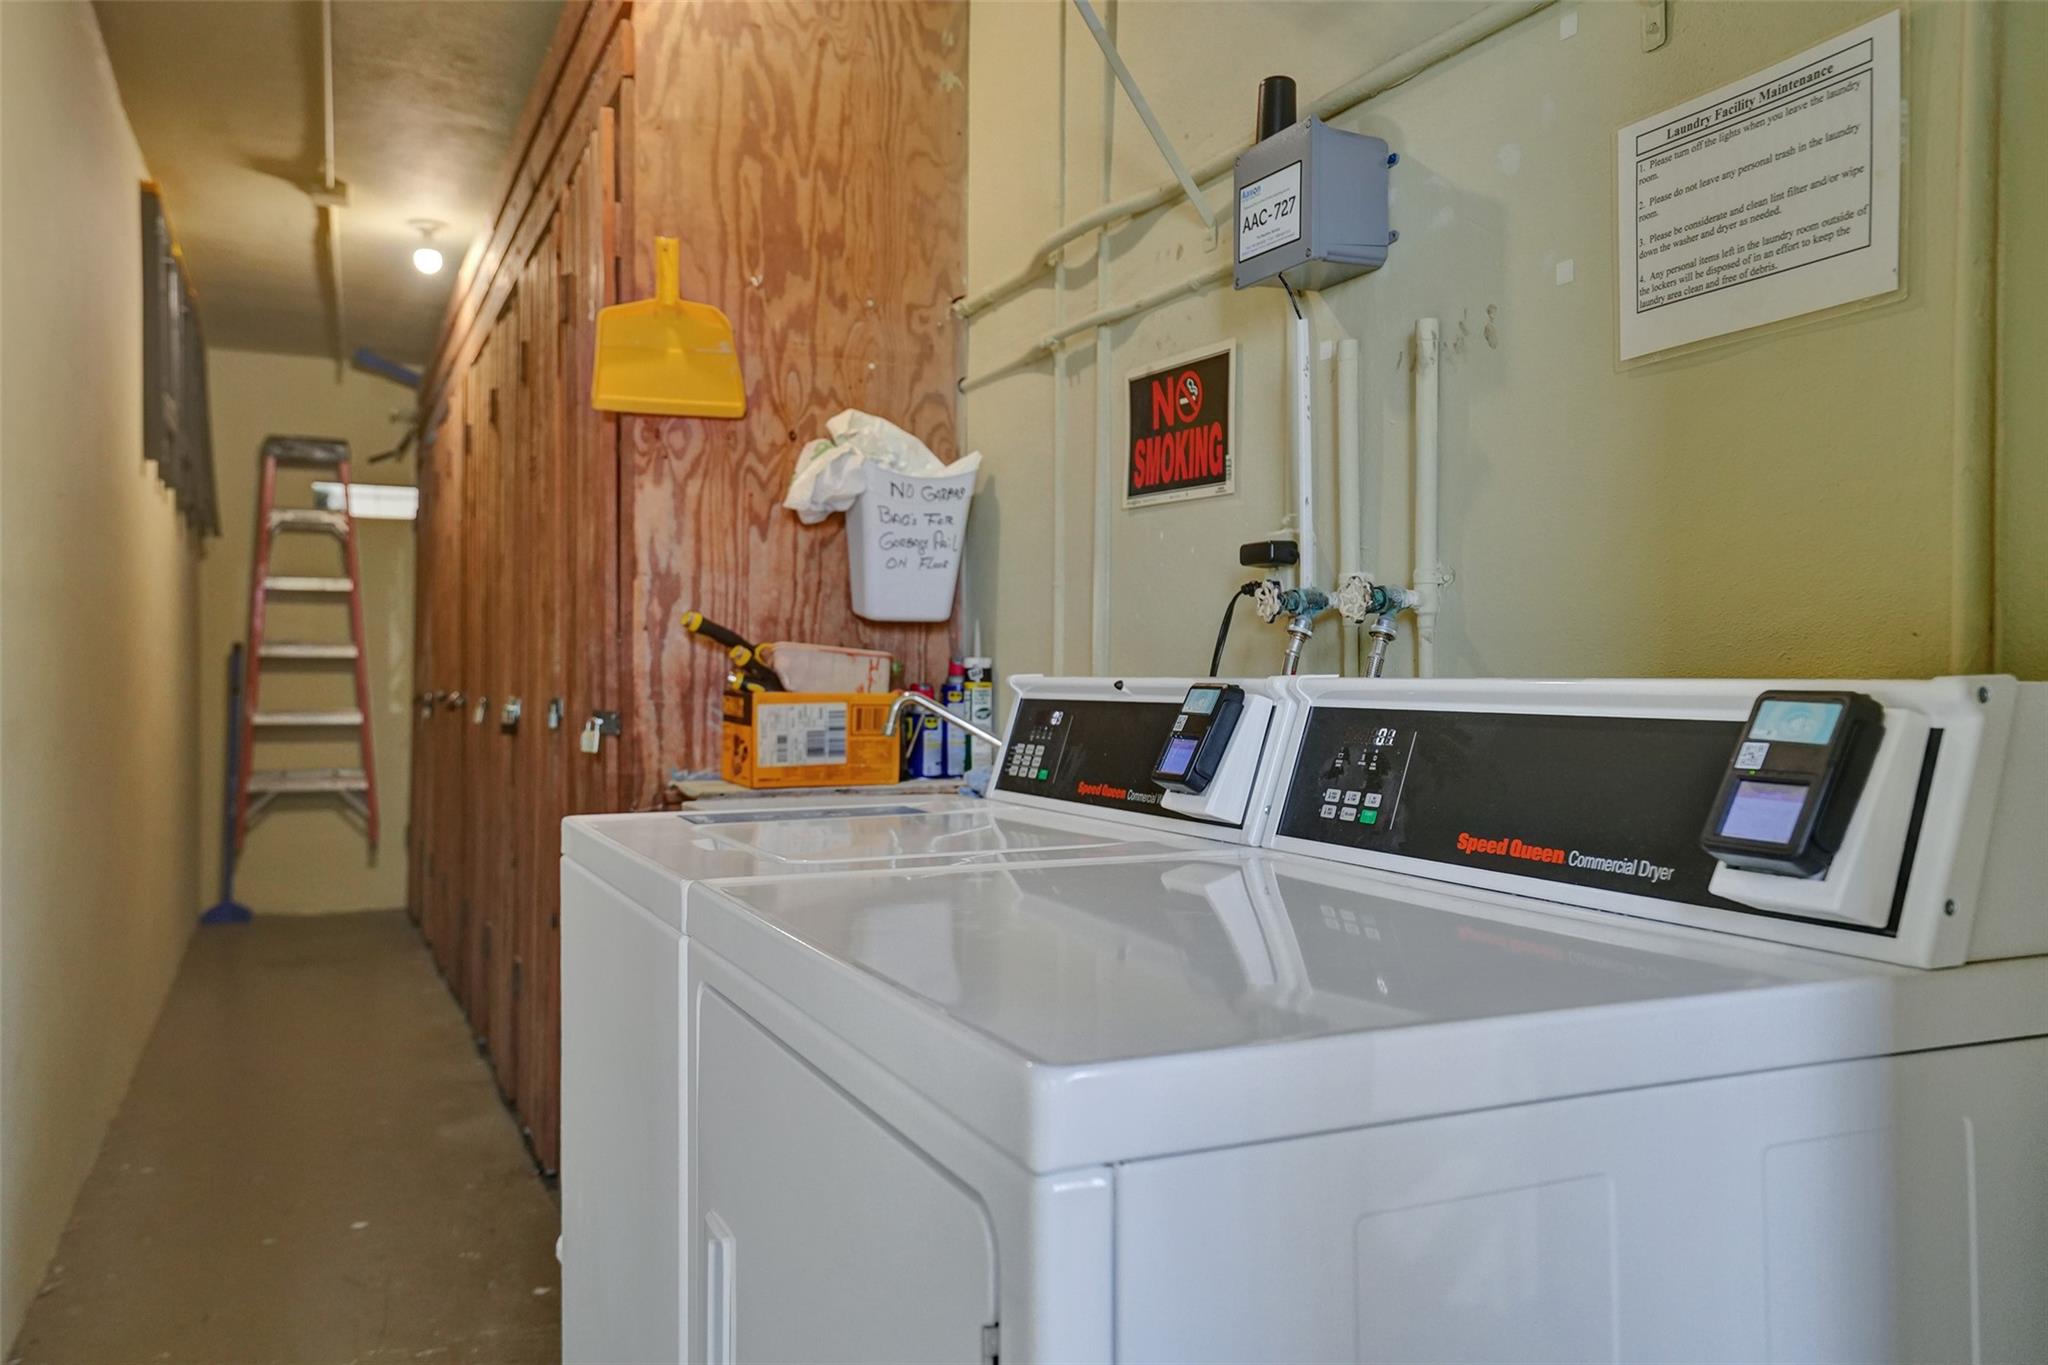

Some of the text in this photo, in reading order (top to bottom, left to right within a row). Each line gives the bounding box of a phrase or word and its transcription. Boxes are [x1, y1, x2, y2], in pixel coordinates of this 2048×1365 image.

[1648, 154, 1672, 169] Please
[1673, 147, 1690, 159] turn
[1690, 139, 1704, 152] off
[1703, 137, 1717, 148] the
[1718, 127, 1741, 142] lights
[1742, 118, 1765, 132] when
[1766, 111, 1783, 125] you
[1784, 101, 1808, 116] leave
[1809, 94, 1824, 106] the
[1825, 79, 1861, 100] laundry
[1666, 64, 1833, 140] Laundry Facility Maintenance
[1648, 192, 1672, 206] Please
[1673, 187, 1684, 197] do
[1684, 181, 1698, 193] not
[1698, 175, 1720, 188] leave
[1721, 168, 1736, 180] any
[1737, 152, 1772, 176] personal
[1774, 145, 1796, 160] trash
[1797, 142, 1806, 152] in
[1808, 137, 1823, 148] the
[1824, 123, 1860, 142] laundry
[1243, 195, 1296, 234] AAC-727
[1649, 230, 1672, 244] Please
[1672, 226, 1683, 235] be
[1683, 211, 1727, 231] considerate
[1728, 203, 1744, 216] and
[1745, 197, 1768, 211] clean
[1769, 191, 1784, 203] lint
[1786, 183, 1808, 197] filter
[1840, 165, 1864, 178] wipe
[1638, 247, 1658, 259] down
[1659, 242, 1671, 252] the
[1672, 233, 1699, 247] washer
[1699, 226, 1715, 239] and
[1715, 220, 1738, 234] dryer
[1738, 217, 1748, 226] as
[1638, 226, 1851, 296] the lockers will be disposed of in an effort to keep the
[1648, 270, 1664, 281] Any
[1665, 258, 1697, 277] personal
[1698, 252, 1720, 266] items
[1721, 246, 1735, 258] left
[1736, 244, 1745, 254] in
[1746, 240, 1760, 250] the
[1761, 230, 1794, 246] laundry
[1795, 222, 1819, 236] room
[1820, 210, 1854, 227] outside
[1856, 204, 1868, 216] of
[1639, 294, 1665, 308] laundry
[1666, 290, 1682, 300] area
[1682, 283, 1703, 295] clean
[1704, 277, 1720, 289] and
[1721, 274, 1737, 285] free
[1738, 268, 1749, 279] of
[1134, 421, 1223, 488] SMOKING
[890, 482, 915, 498] NO
[886, 557, 907, 569] ON
[1078, 781, 1102, 796] Speed
[1102, 784, 1126, 799] Queen
[1127, 789, 1157, 804] Commercial
[1456, 831, 1675, 883] Speed Queen Commercial Dryer
